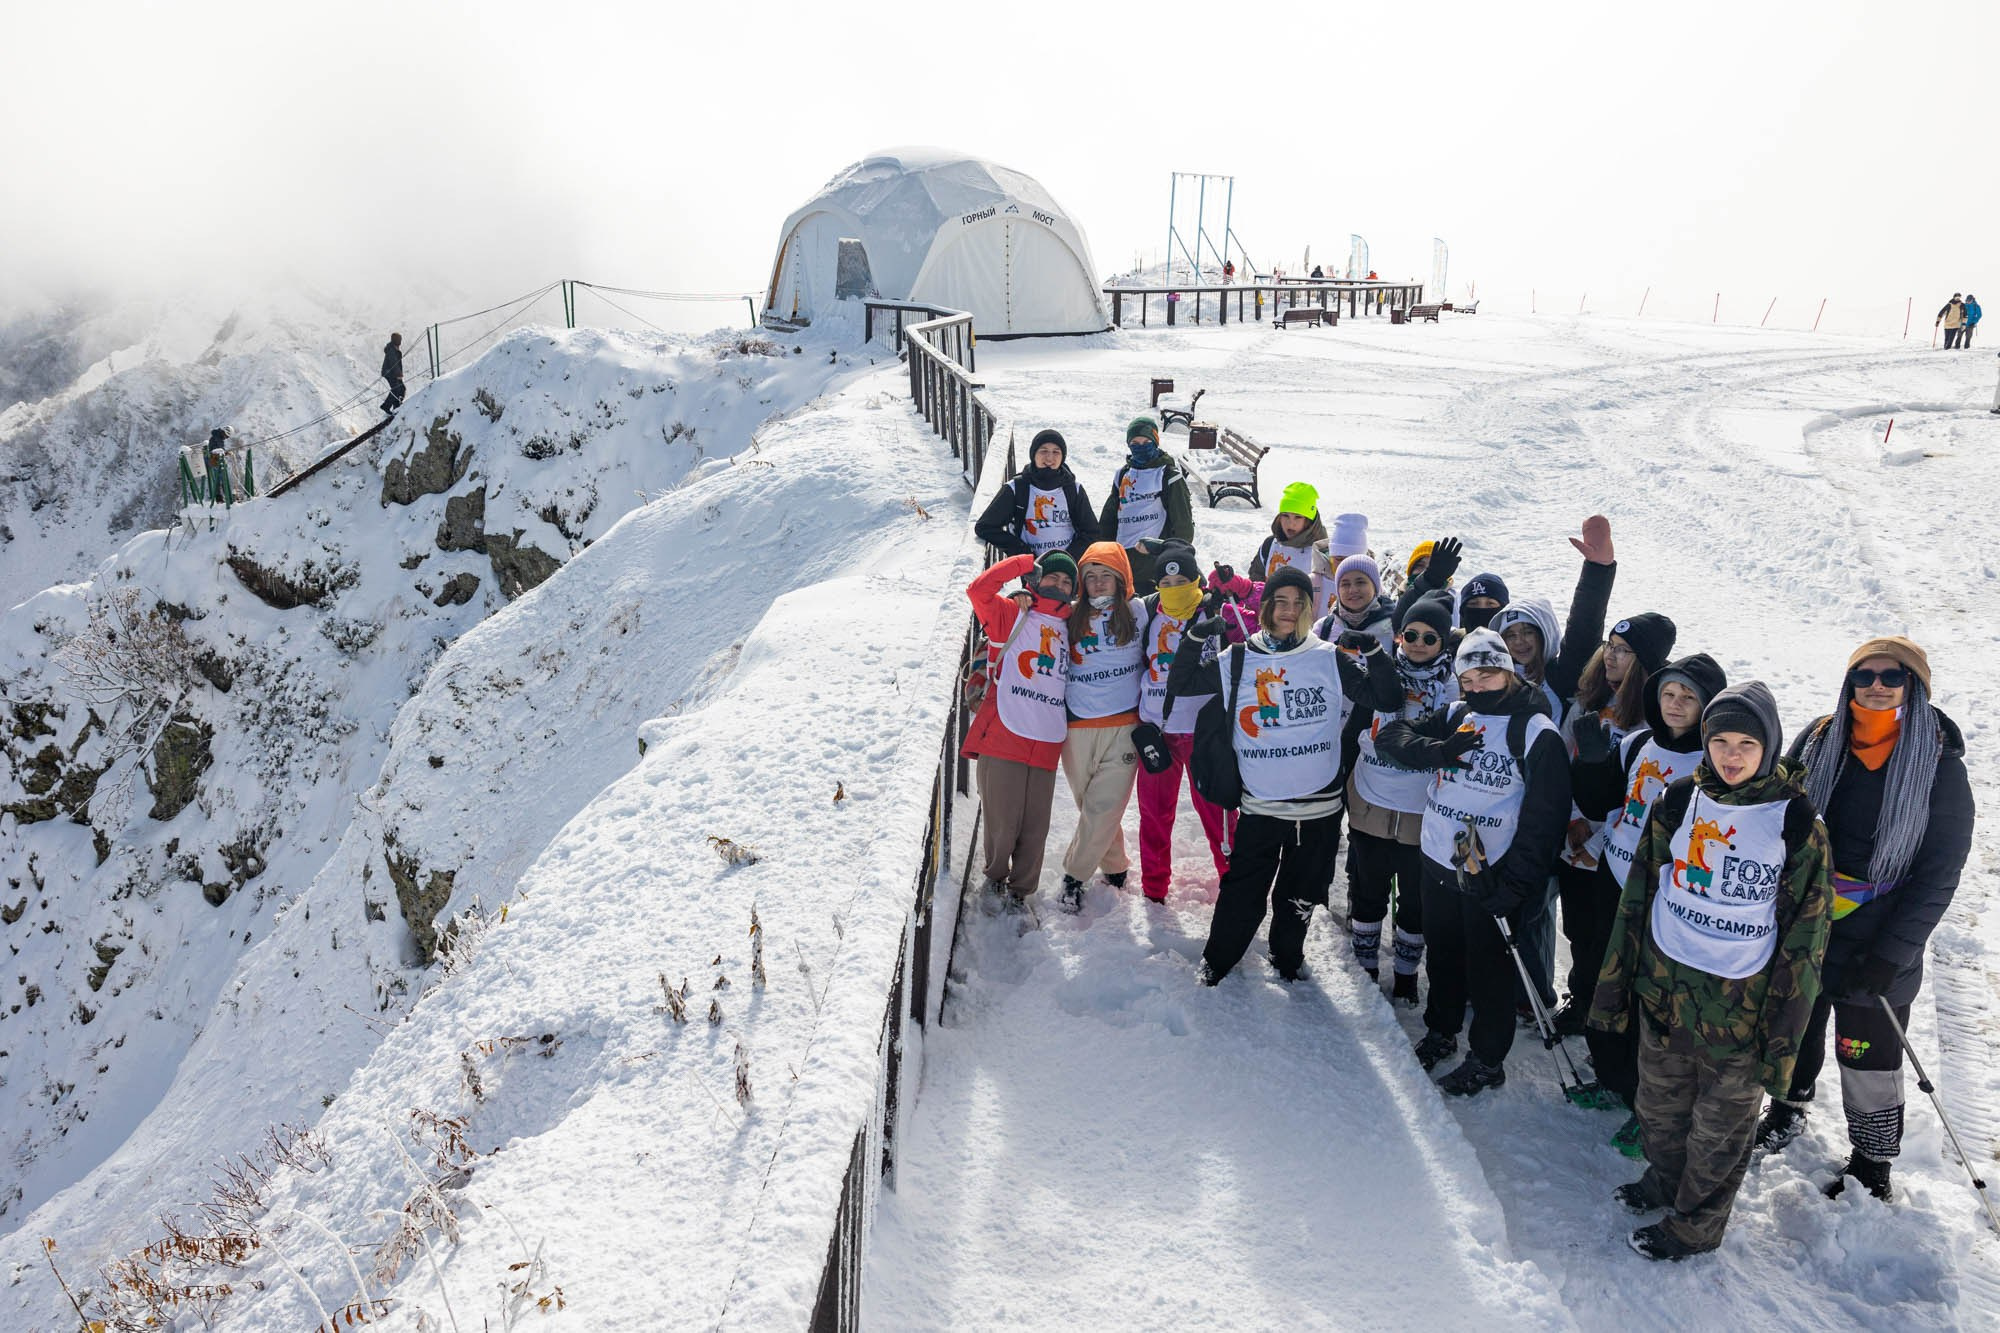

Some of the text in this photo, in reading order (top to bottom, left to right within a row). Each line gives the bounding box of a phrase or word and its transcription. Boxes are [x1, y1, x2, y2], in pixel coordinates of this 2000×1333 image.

[962, 206, 1055, 227] ГОРНЫЙ МОСТ
[1052, 510, 1071, 522] FO
[1472, 581, 1487, 595] LA
[1283, 686, 1326, 708] FOX
[1286, 704, 1327, 721] CAMP
[1241, 741, 1331, 759] WWW.FOX-CAMP.RU
[1469, 748, 1514, 776] FOX
[1464, 768, 1511, 788] CAMP
[1722, 855, 1780, 886] FOX
[1721, 881, 1776, 901] CAMP
